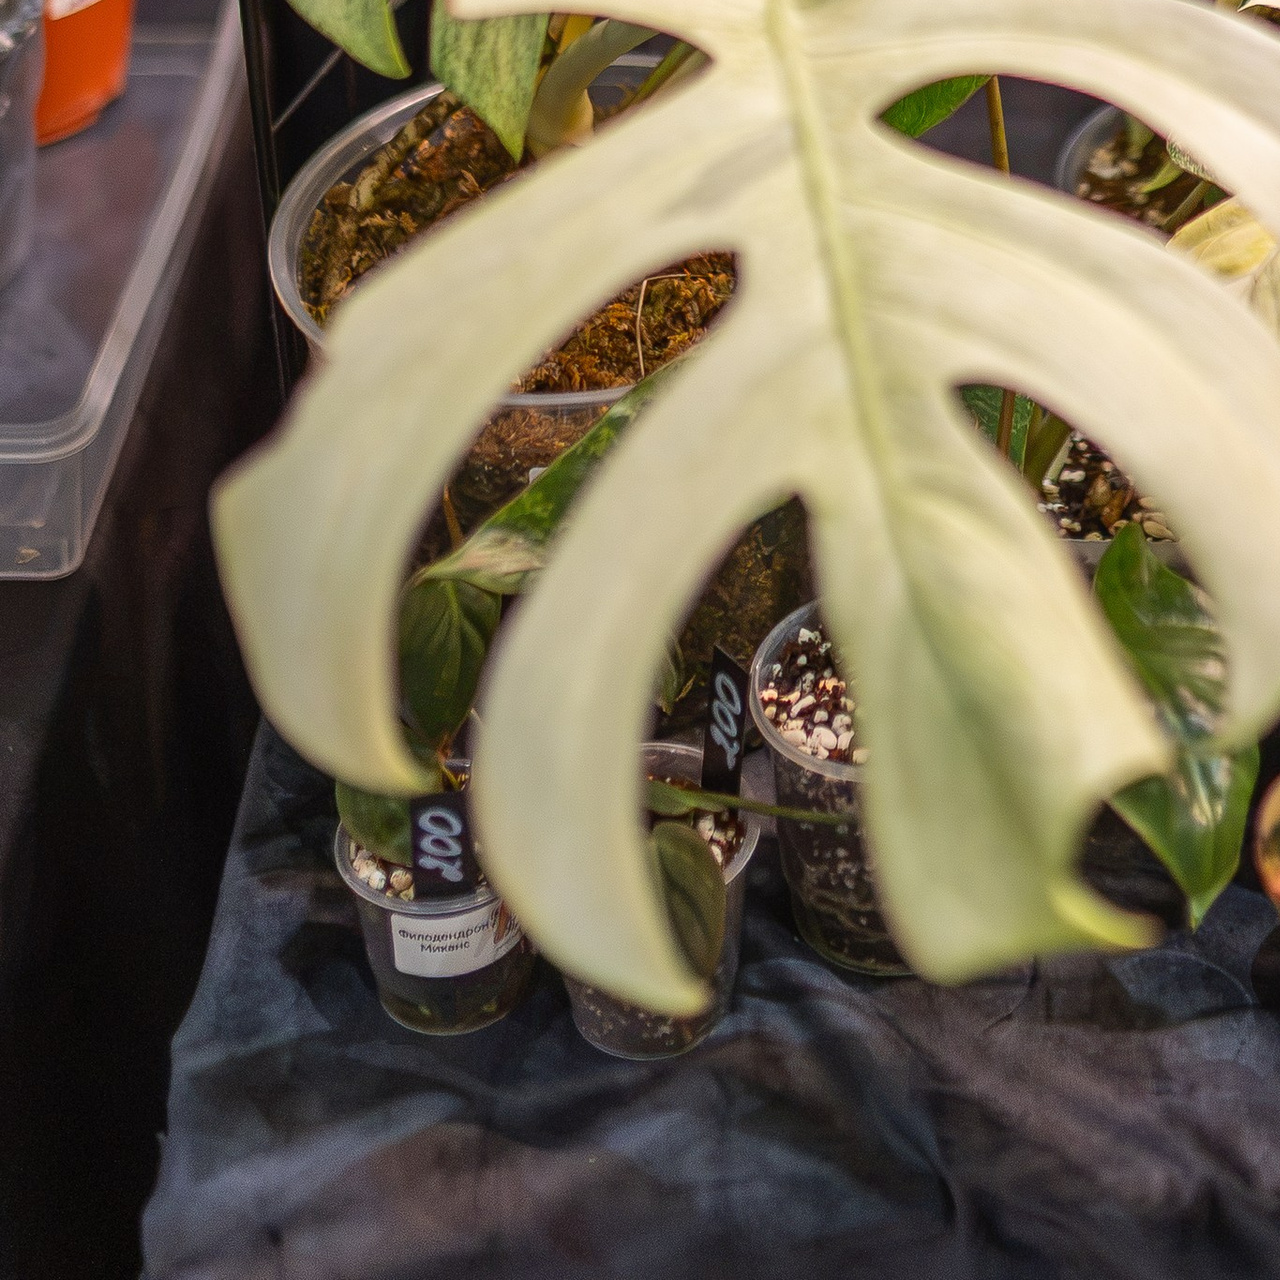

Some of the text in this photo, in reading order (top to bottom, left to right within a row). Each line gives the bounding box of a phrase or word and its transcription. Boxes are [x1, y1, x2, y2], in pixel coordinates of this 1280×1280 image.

[710, 672, 742, 771] 200
[418, 806, 463, 883] 200
[398, 920, 489, 943] Филодендрон
